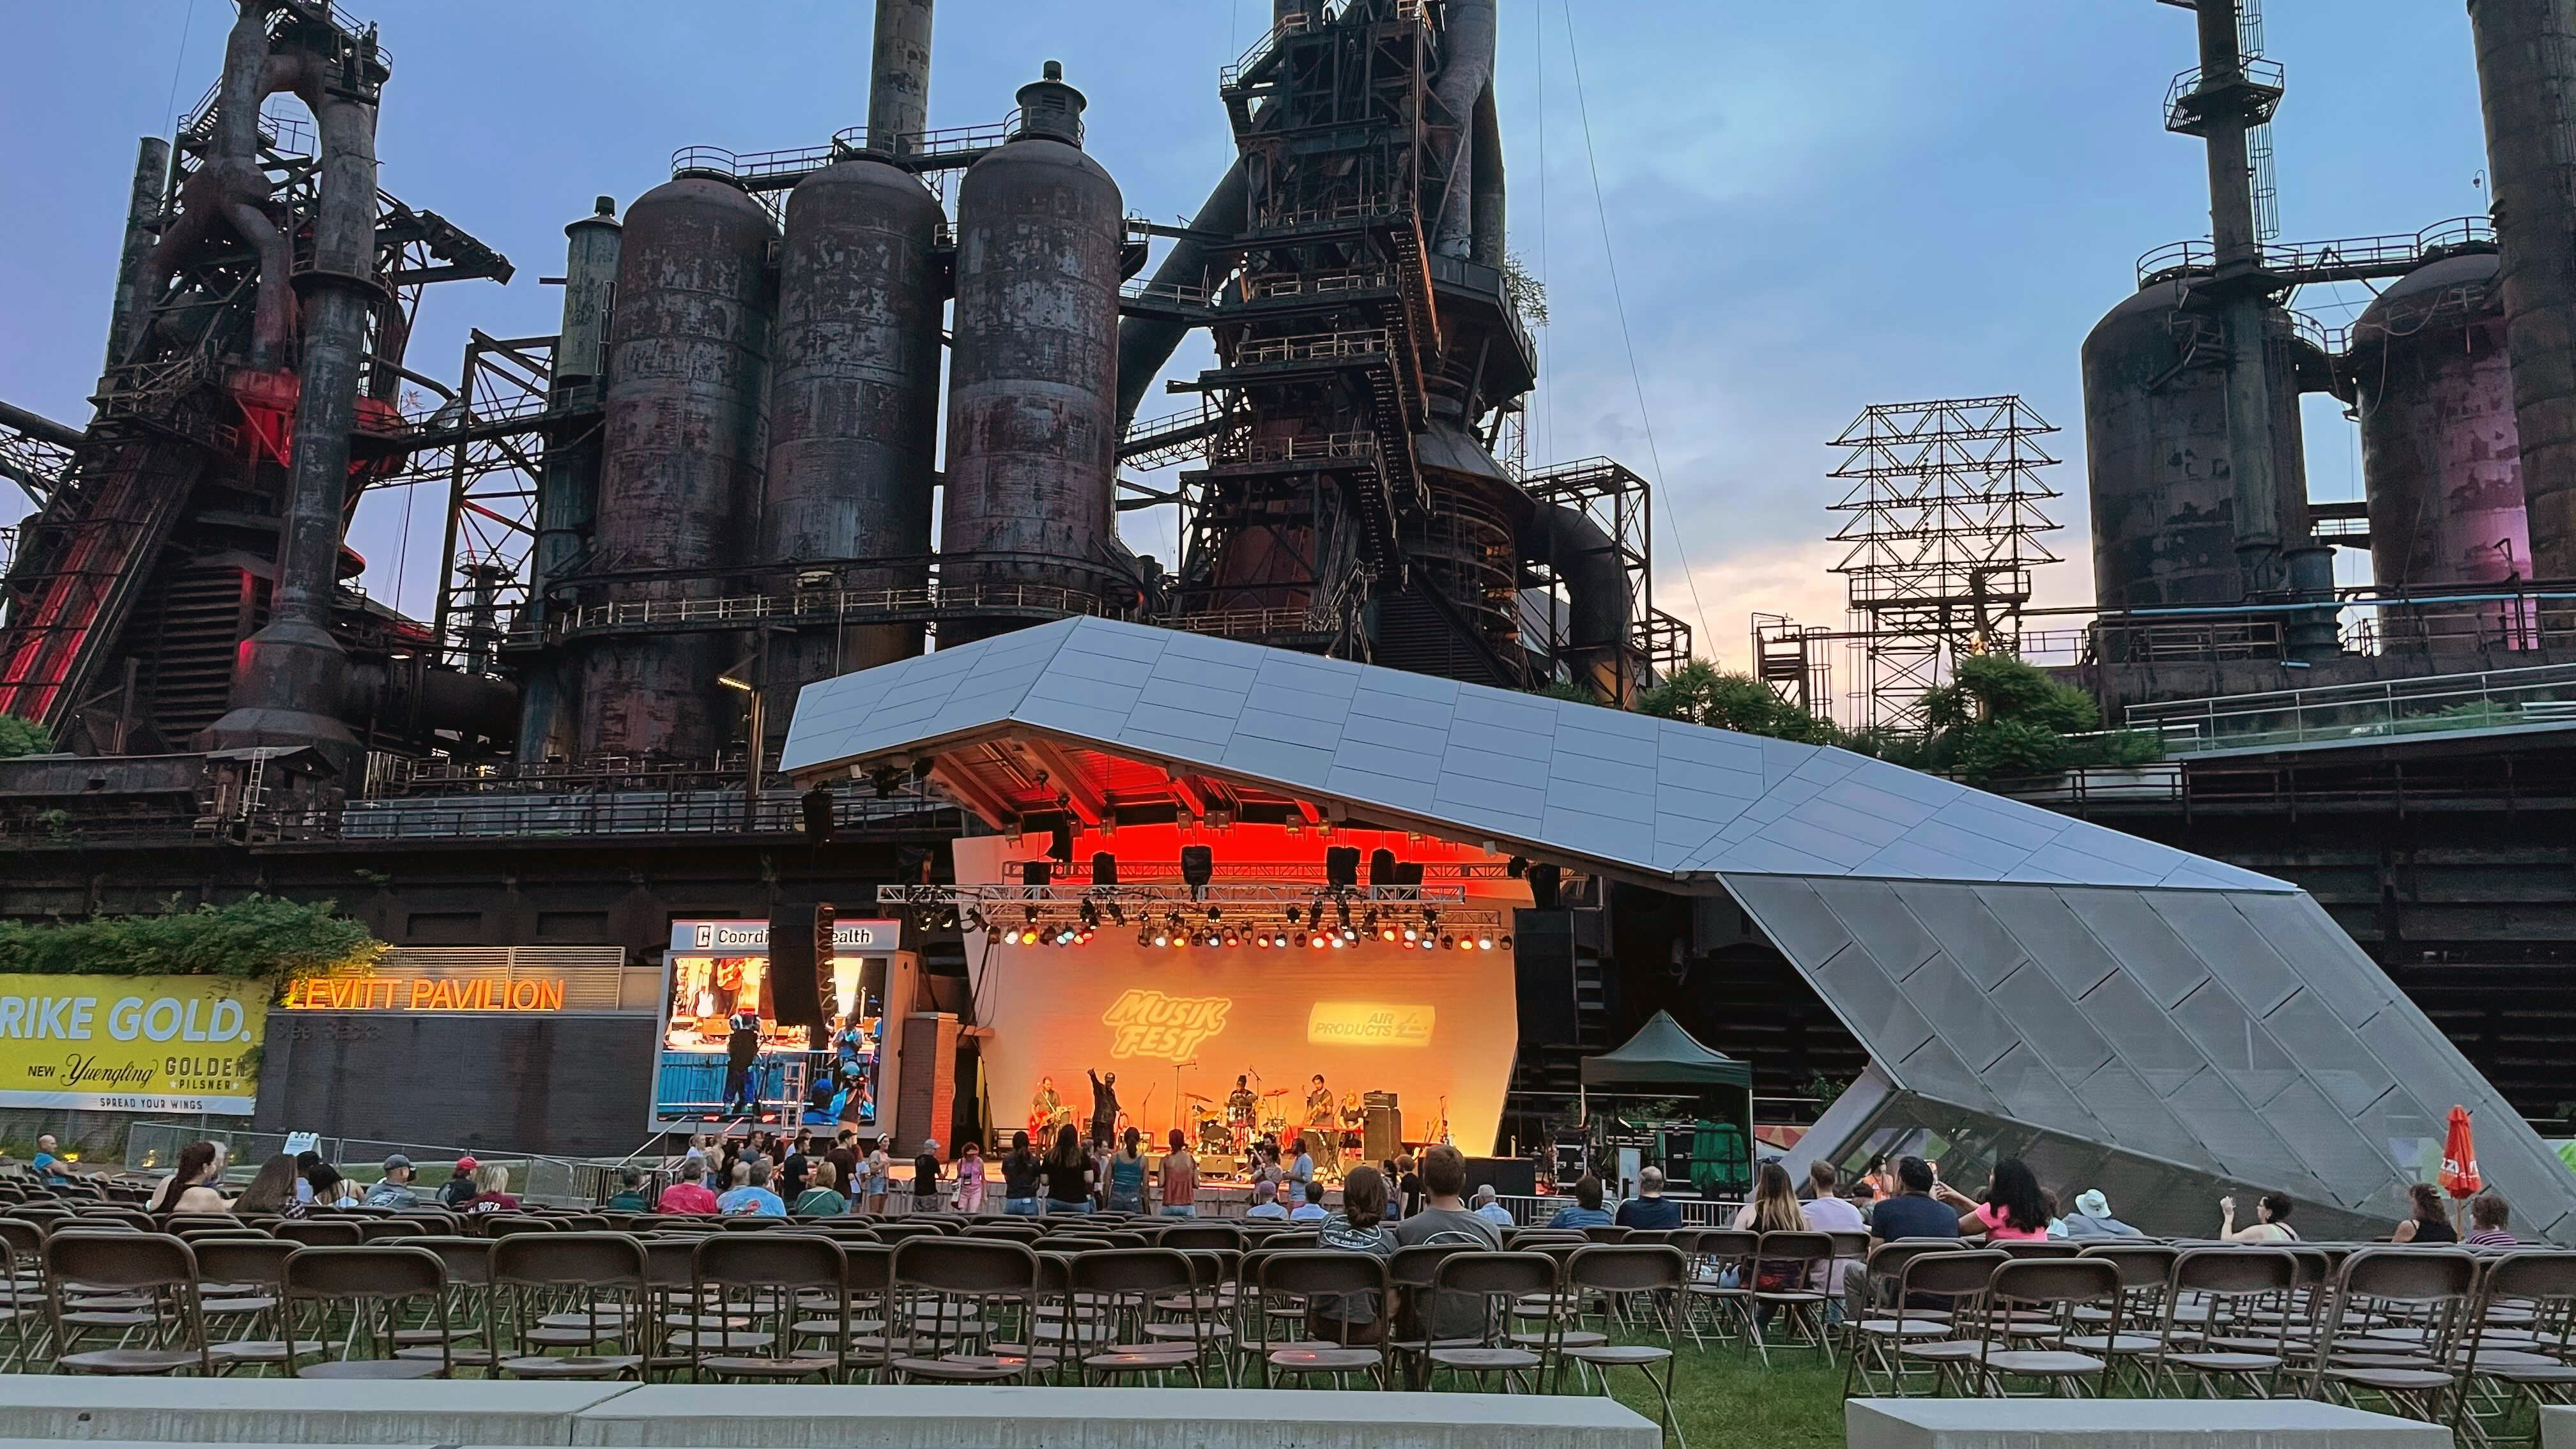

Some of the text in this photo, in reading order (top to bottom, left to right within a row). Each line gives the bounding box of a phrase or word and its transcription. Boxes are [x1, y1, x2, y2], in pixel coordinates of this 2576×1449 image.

[719, 930, 769, 944] Coordi
[832, 930, 870, 943] ealth
[286, 979, 564, 1010] LEVITT PAVILION
[0, 997, 251, 1042] RIKE GOLD.
[1368, 1013, 1395, 1024] AIR
[1314, 1023, 1392, 1037] PRODUCTS
[1116, 1025, 1206, 1057] FEST
[27, 1054, 158, 1088] NEW Yuengling
[165, 1057, 245, 1077] GOLDEN
[179, 1079, 231, 1090] PILSNER
[100, 1098, 203, 1110] SPREAD YOUR WINGS
